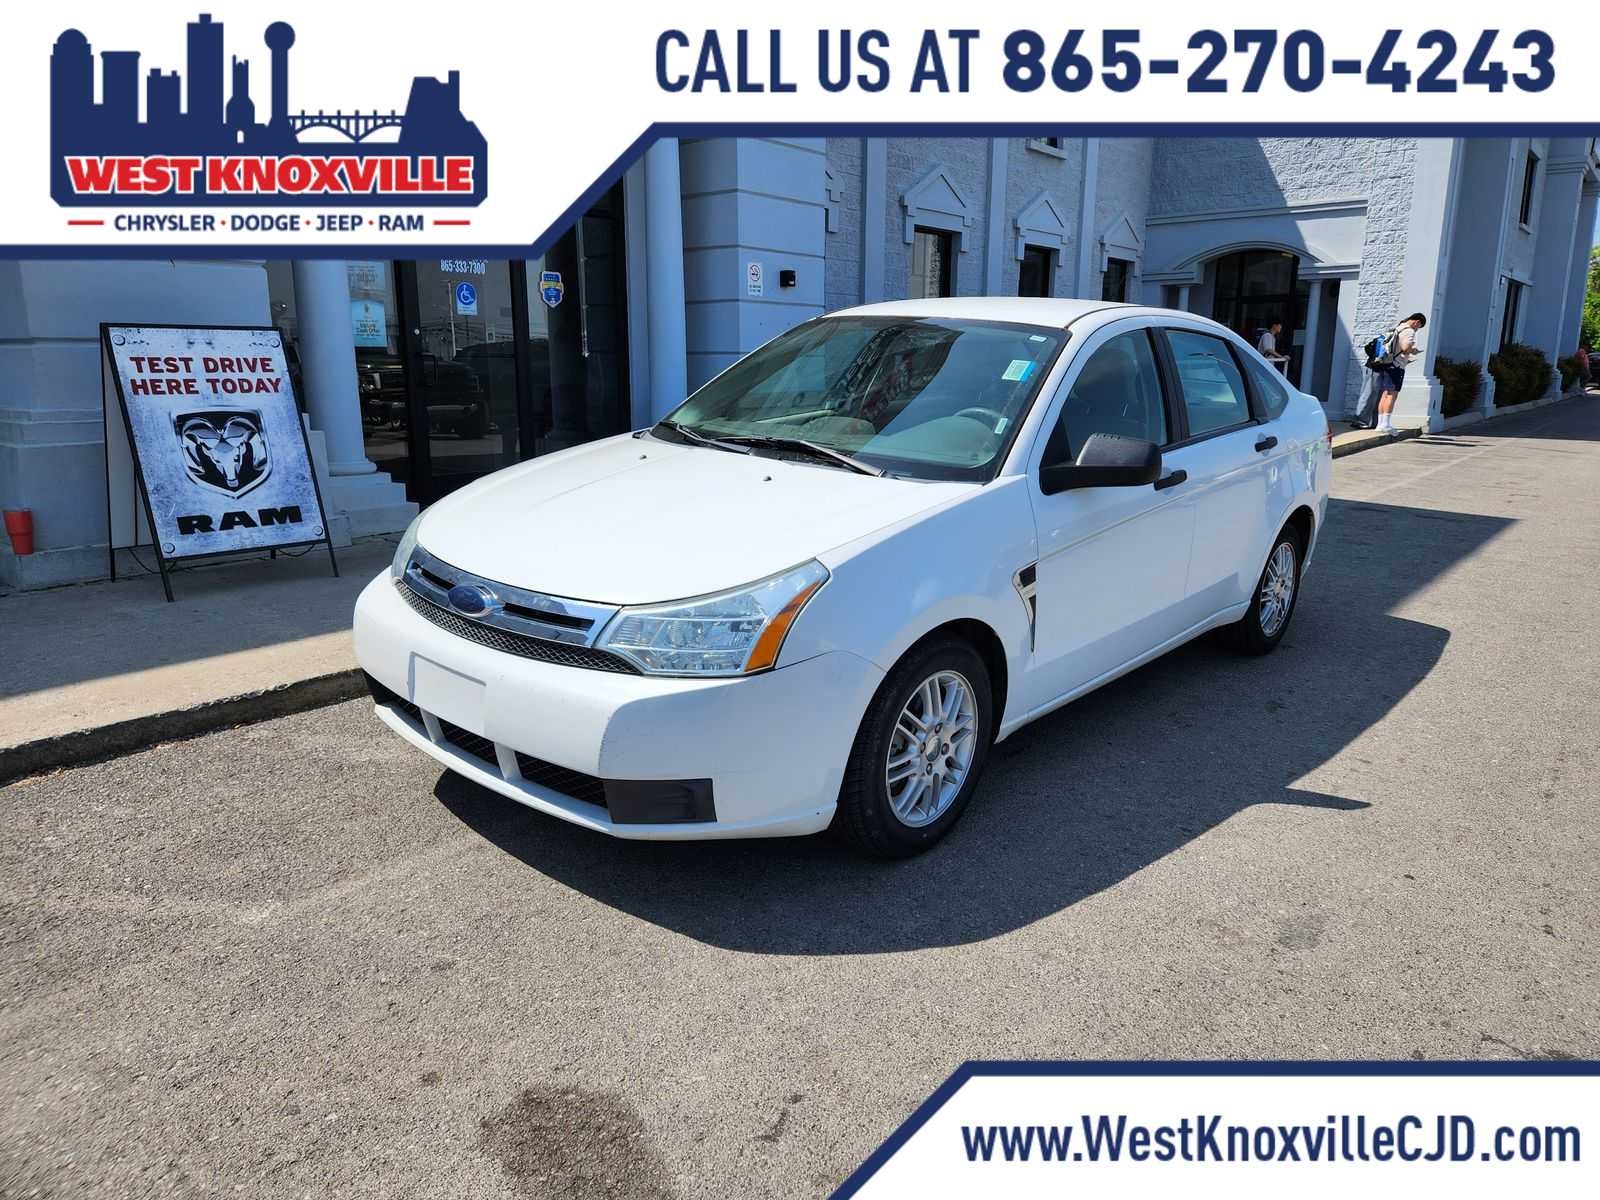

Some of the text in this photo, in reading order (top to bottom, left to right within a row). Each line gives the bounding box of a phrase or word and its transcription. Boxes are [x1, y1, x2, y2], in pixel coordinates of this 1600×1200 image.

[129, 356, 275, 373] TEST DRIVE
[130, 378, 281, 395] HERE TODAY
[176, 505, 303, 535] RAM
